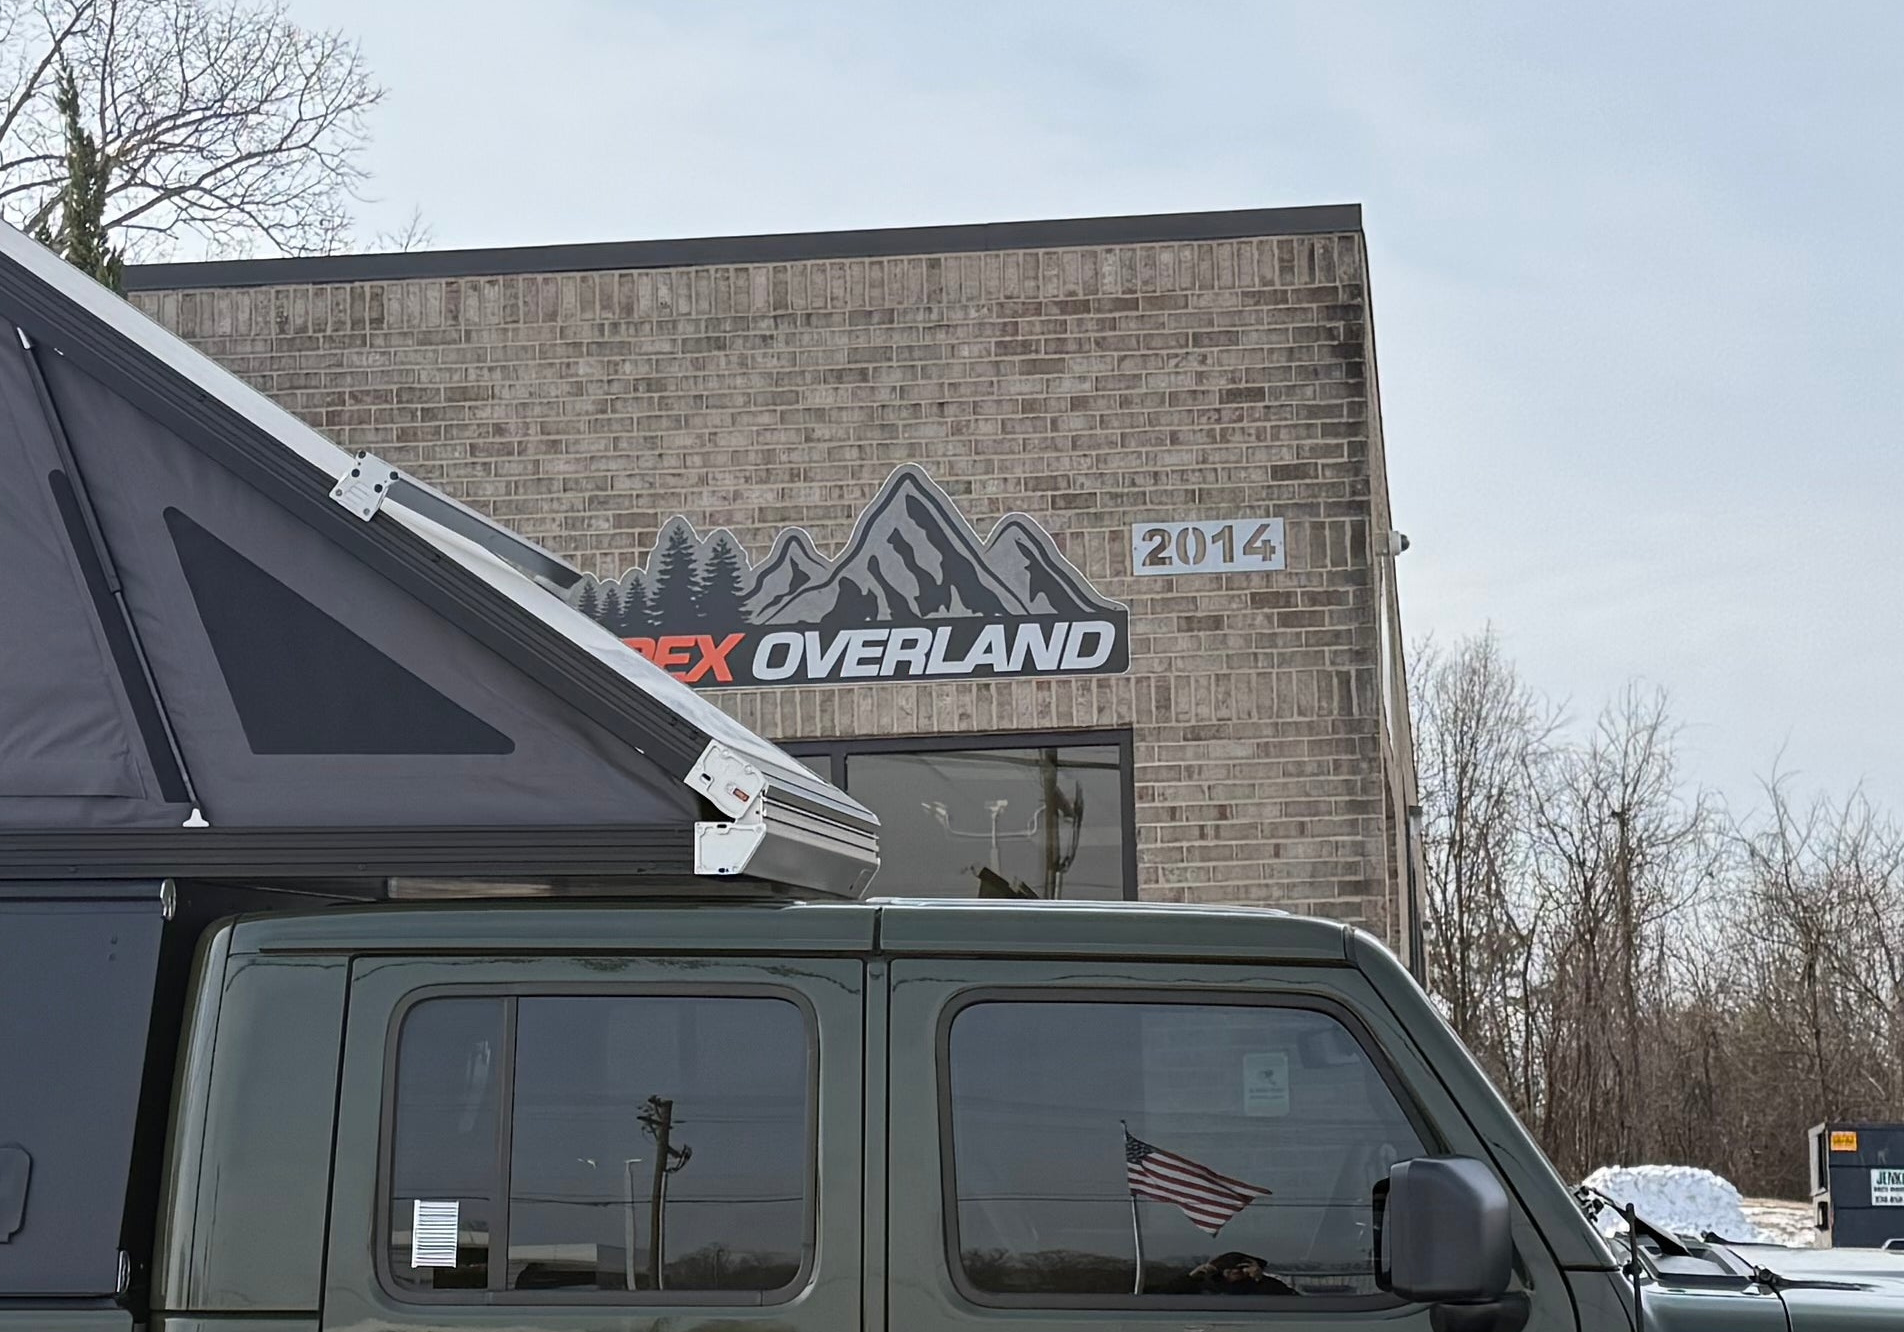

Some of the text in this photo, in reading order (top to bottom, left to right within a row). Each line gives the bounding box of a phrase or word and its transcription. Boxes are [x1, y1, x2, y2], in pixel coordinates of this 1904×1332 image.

[1140, 522, 1277, 567] 2014
[620, 620, 1116, 683] EX OVERLAND
